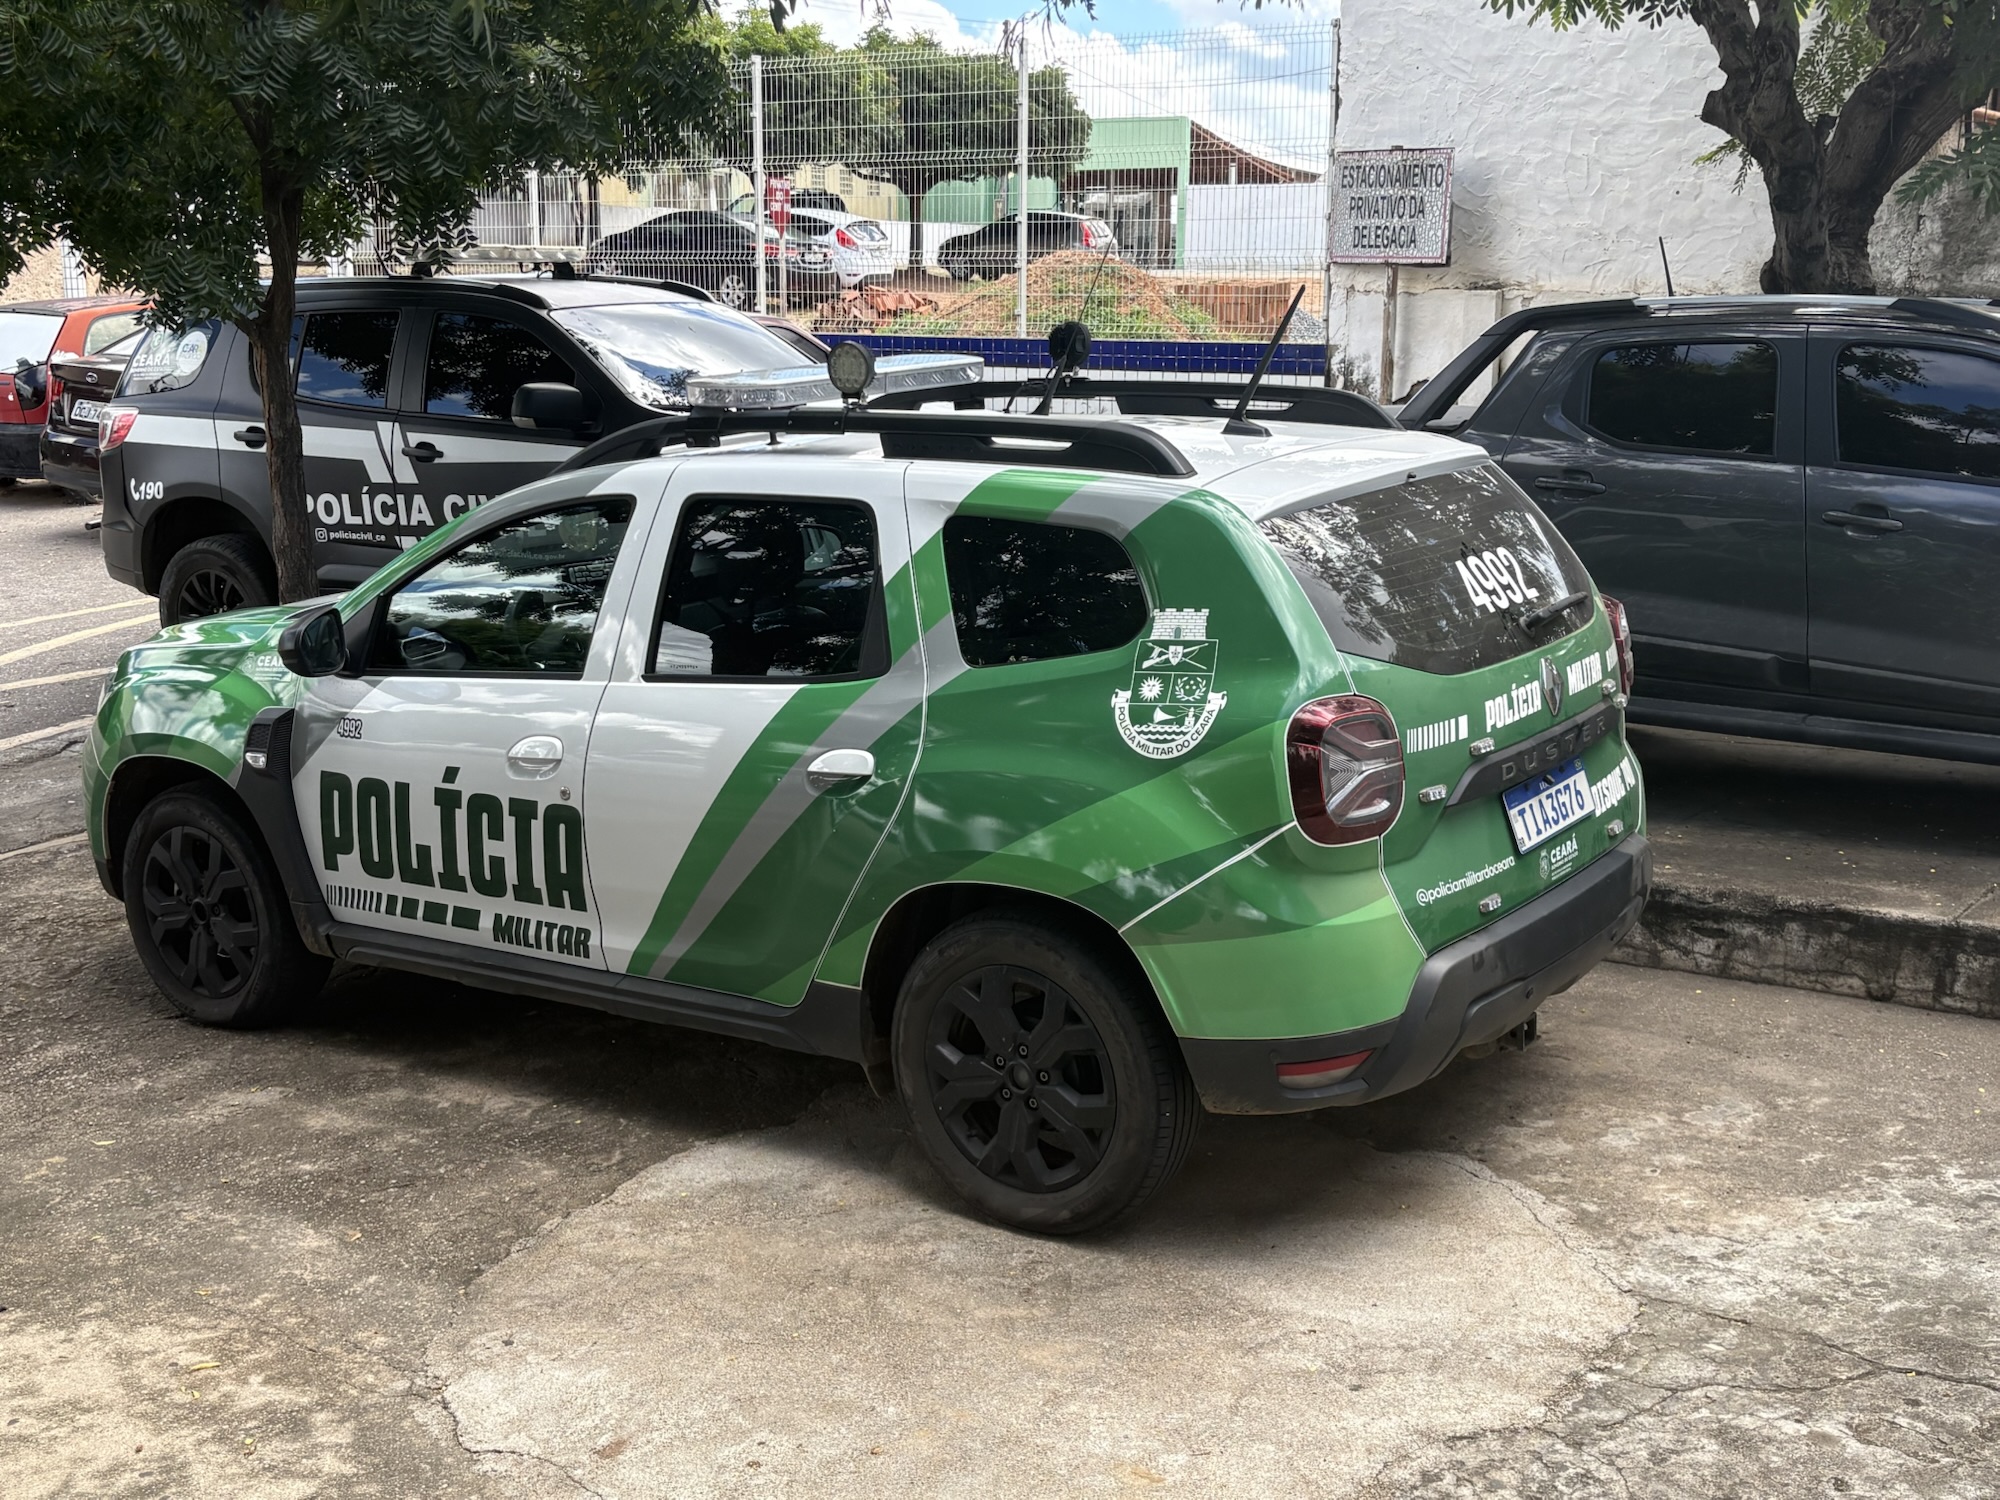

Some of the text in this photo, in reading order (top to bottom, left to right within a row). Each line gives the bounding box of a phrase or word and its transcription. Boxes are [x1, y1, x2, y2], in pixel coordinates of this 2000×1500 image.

[1341, 163, 1444, 189] ESTACIONAMENTO
[1349, 195, 1425, 219] PRIVATIVO DA
[1353, 225, 1417, 249] DELEGACIA
[139, 481, 164, 500] 190
[1455, 546, 1540, 613] 4992
[1485, 651, 1602, 733] POLÍCIA MILITAR
[337, 717, 362, 740] 4992
[1118, 706, 1216, 757] POLÍCIA MILITAR DO CEARÁ
[1502, 715, 1606, 781] DUSTER
[1517, 778, 1585, 842] TIA3G76
[319, 766, 588, 912] POLÍCIA
[1550, 832, 1579, 864] CEARÁ
[1416, 855, 1516, 907] @policiamilitardoceara
[492, 912, 591, 959] MILITAR
